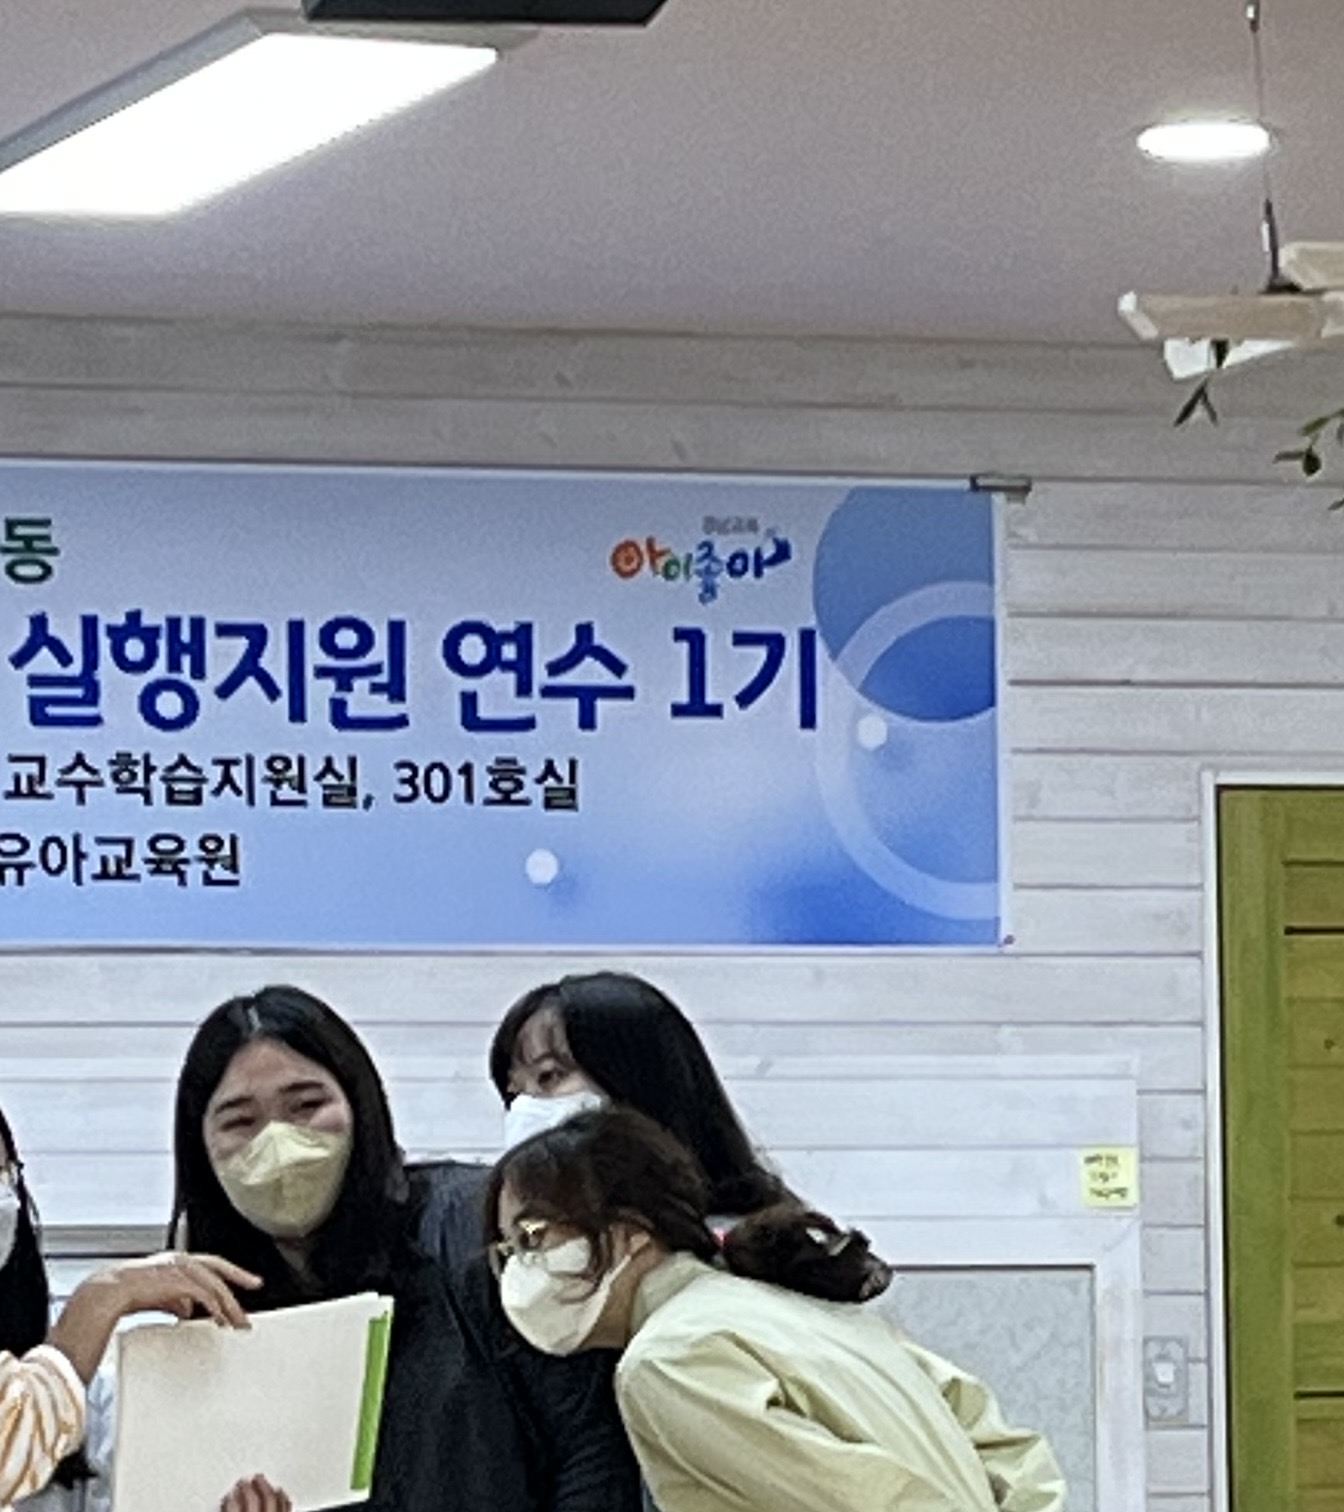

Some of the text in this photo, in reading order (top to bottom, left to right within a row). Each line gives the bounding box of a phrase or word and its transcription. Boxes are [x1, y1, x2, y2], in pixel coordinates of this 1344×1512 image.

[8, 611, 410, 732] 실행지원
[442, 621, 636, 733] 연수
[670, 627, 818, 731] 1기
[2, 750, 375, 812] 교수학습지원실,
[394, 756, 579, 813] 301호실
